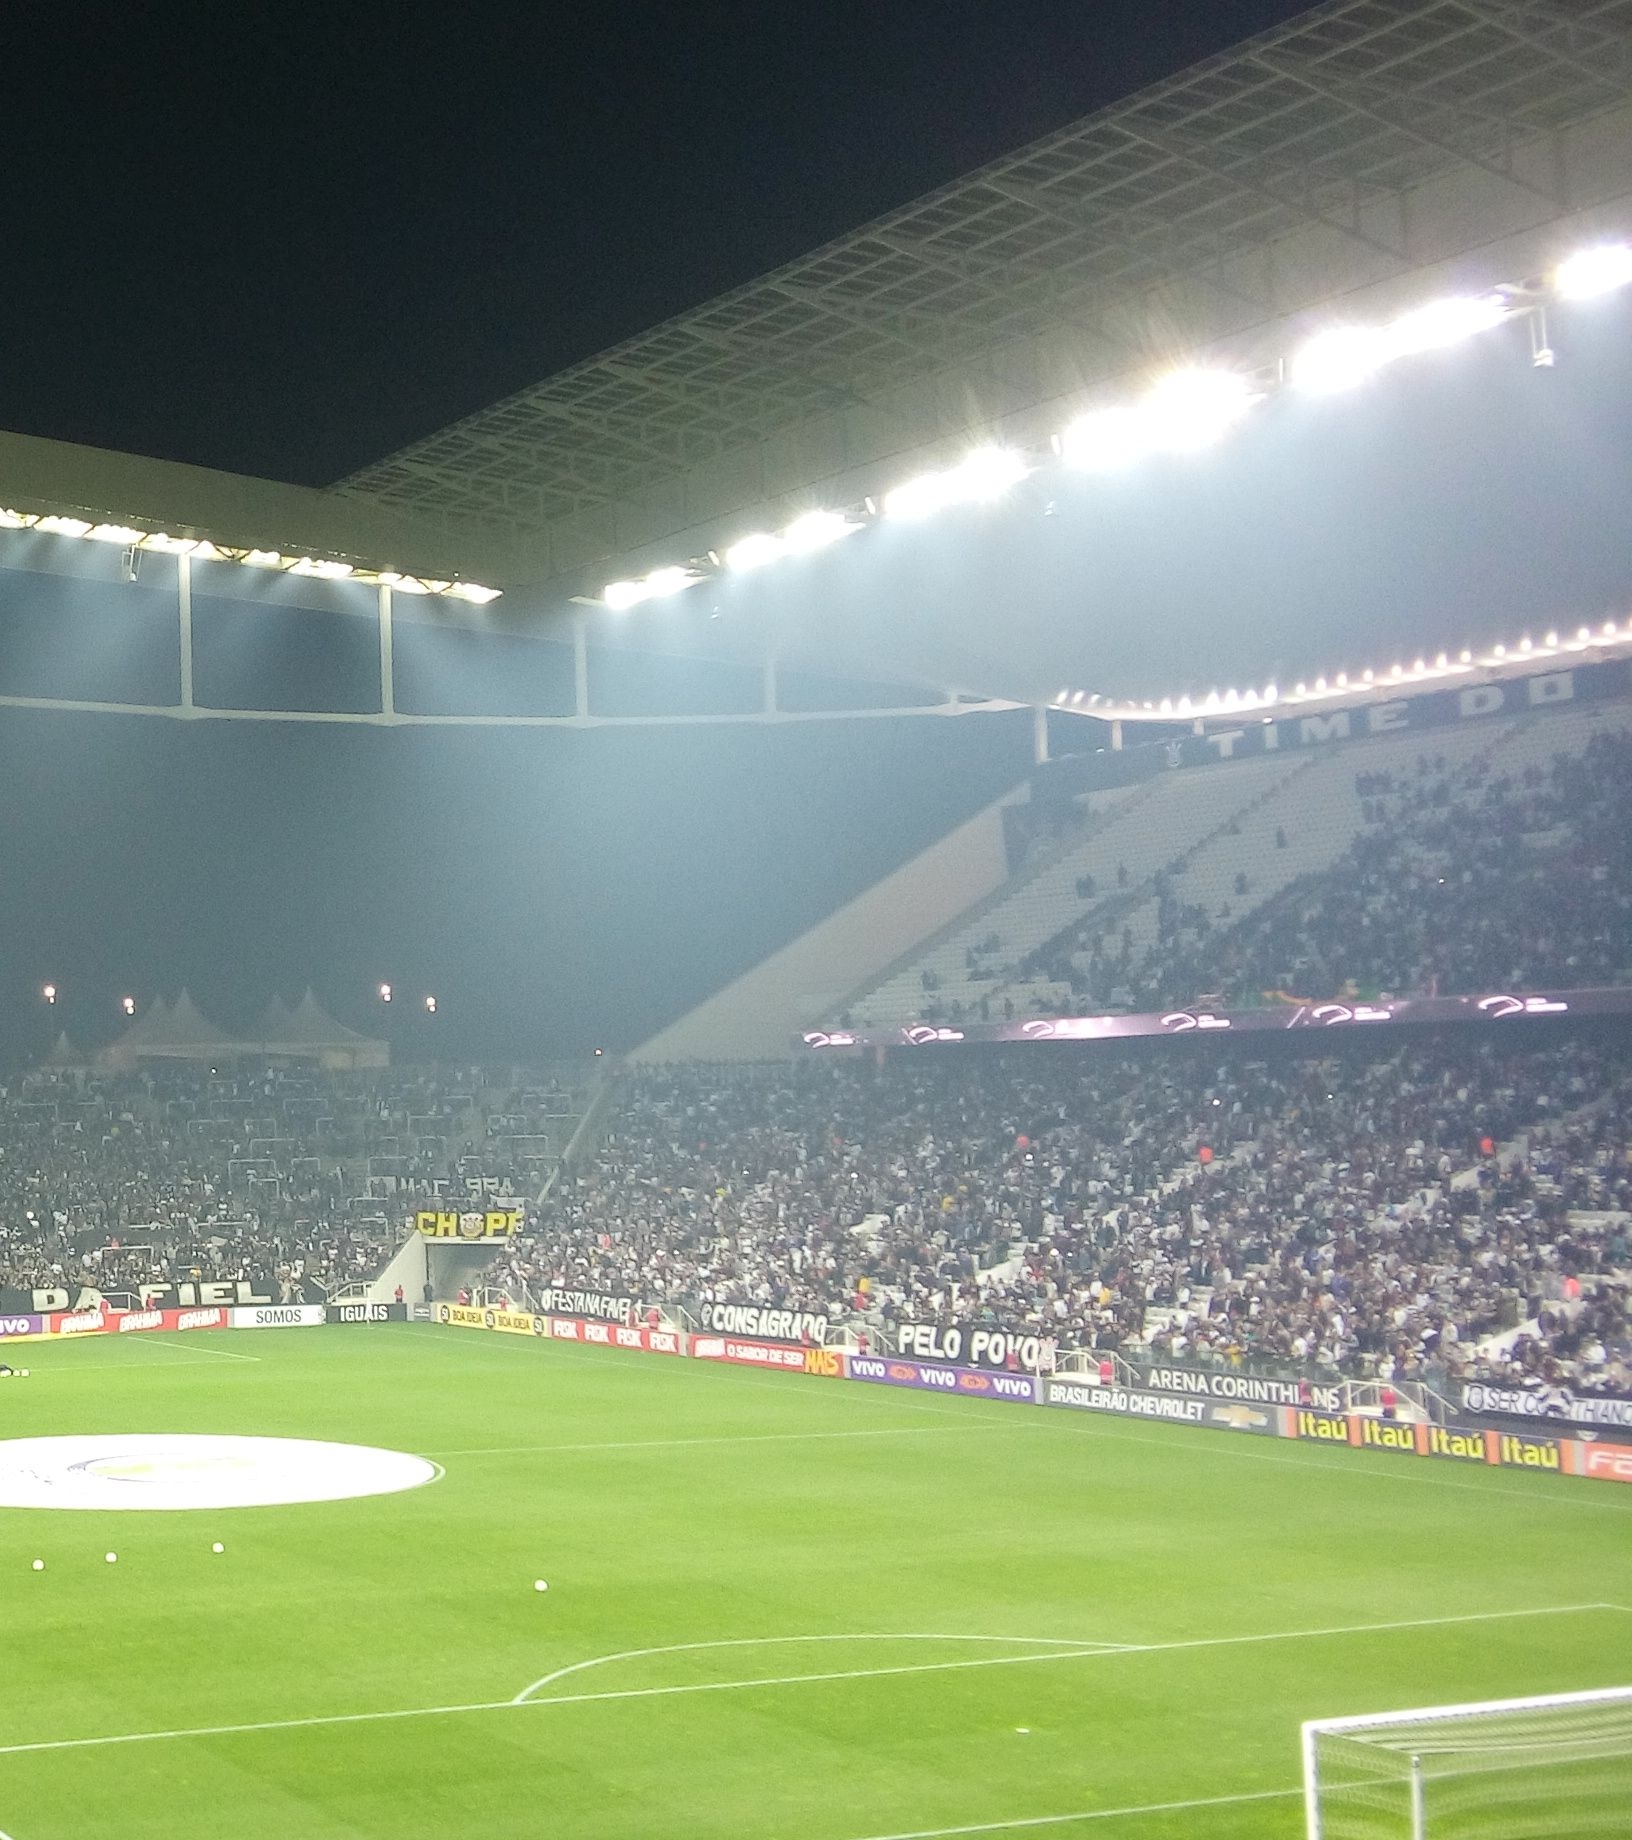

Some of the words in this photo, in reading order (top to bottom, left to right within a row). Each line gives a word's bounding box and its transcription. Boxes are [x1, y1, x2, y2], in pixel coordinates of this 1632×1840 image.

[1208, 701, 1409, 757] TIME
[1459, 670, 1574, 717] DO
[32, 1286, 102, 1313] DA
[139, 1280, 272, 1311] FIEL
[340, 1305, 388, 1321] IGUAIS
[256, 1309, 302, 1323] SOMOS
[712, 1303, 828, 1344] CONSAGRADO
[898, 1323, 962, 1359] PELO
[971, 1330, 1039, 1367] POVO
[1050, 1383, 1127, 1411] BRASILEIRÃO
[1129, 1394, 1205, 1421] CHEVROLET
[1149, 1369, 1209, 1394] ARENA
[1212, 1375, 1340, 1409] CORINTHINS
[1299, 1411, 1347, 1440] Itaú
[1363, 1418, 1414, 1449] Itaú
[1430, 1427, 1484, 1459] Itaú
[1502, 1435, 1559, 1469] Itaú
